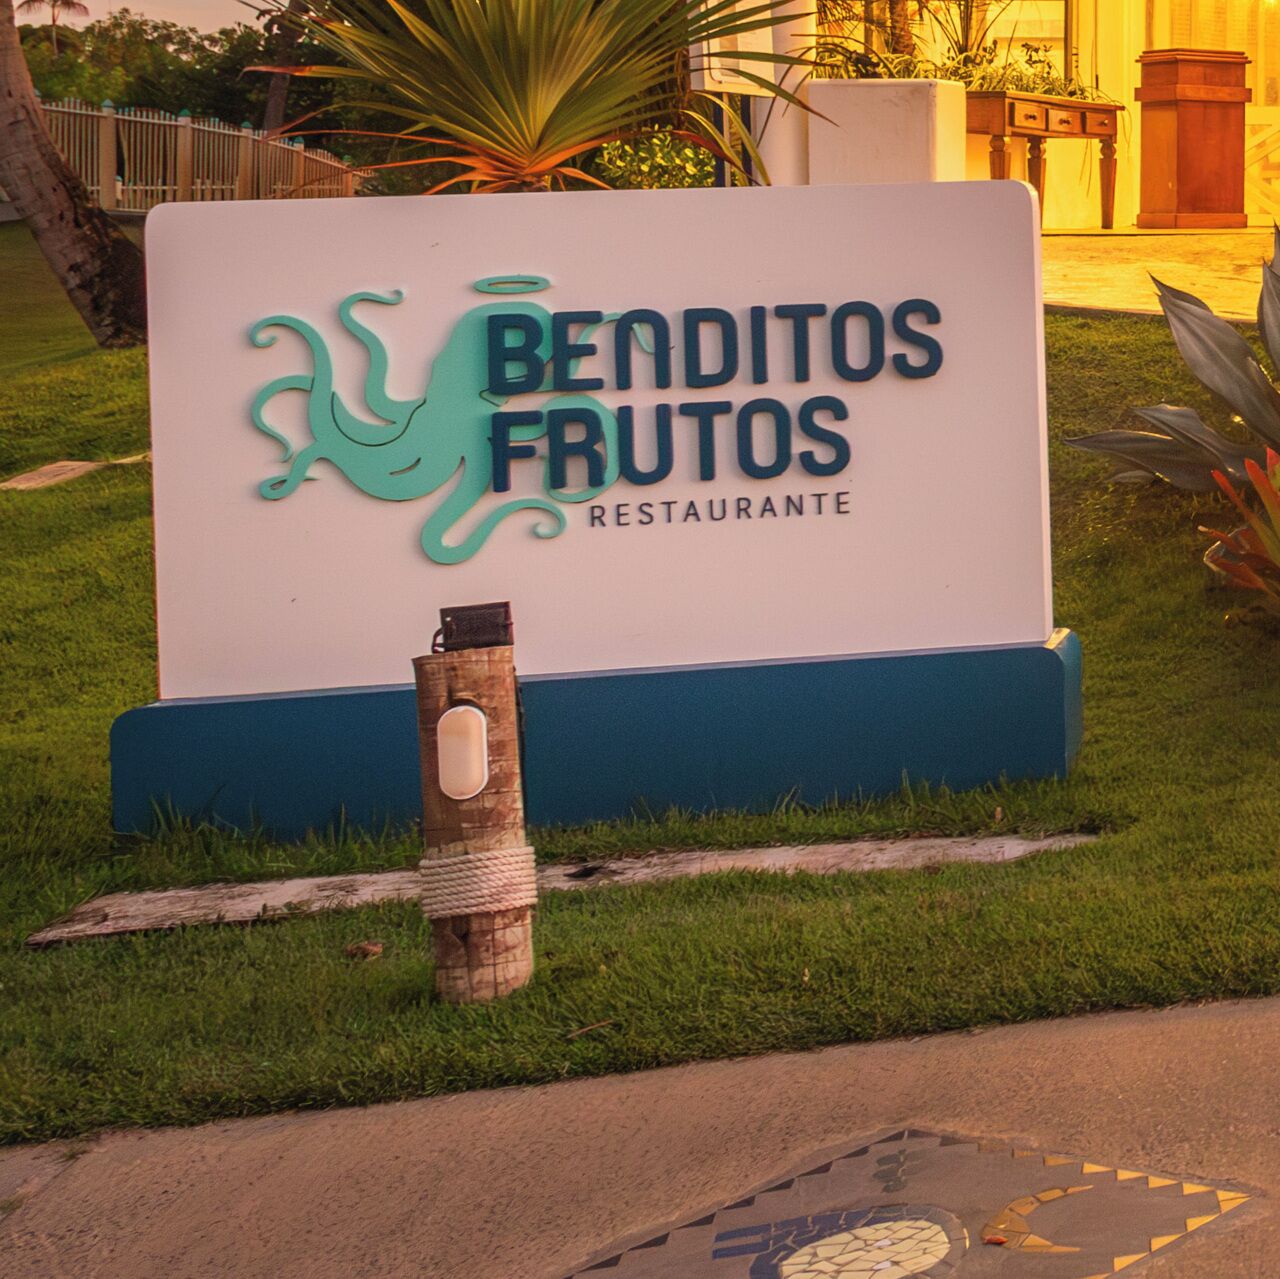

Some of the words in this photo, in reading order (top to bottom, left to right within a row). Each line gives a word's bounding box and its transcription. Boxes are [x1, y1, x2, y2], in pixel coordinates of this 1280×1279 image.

[487, 298, 944, 396] BENDITOS
[489, 396, 852, 493] FRUTOS
[589, 492, 852, 528] RESTAURANTE
